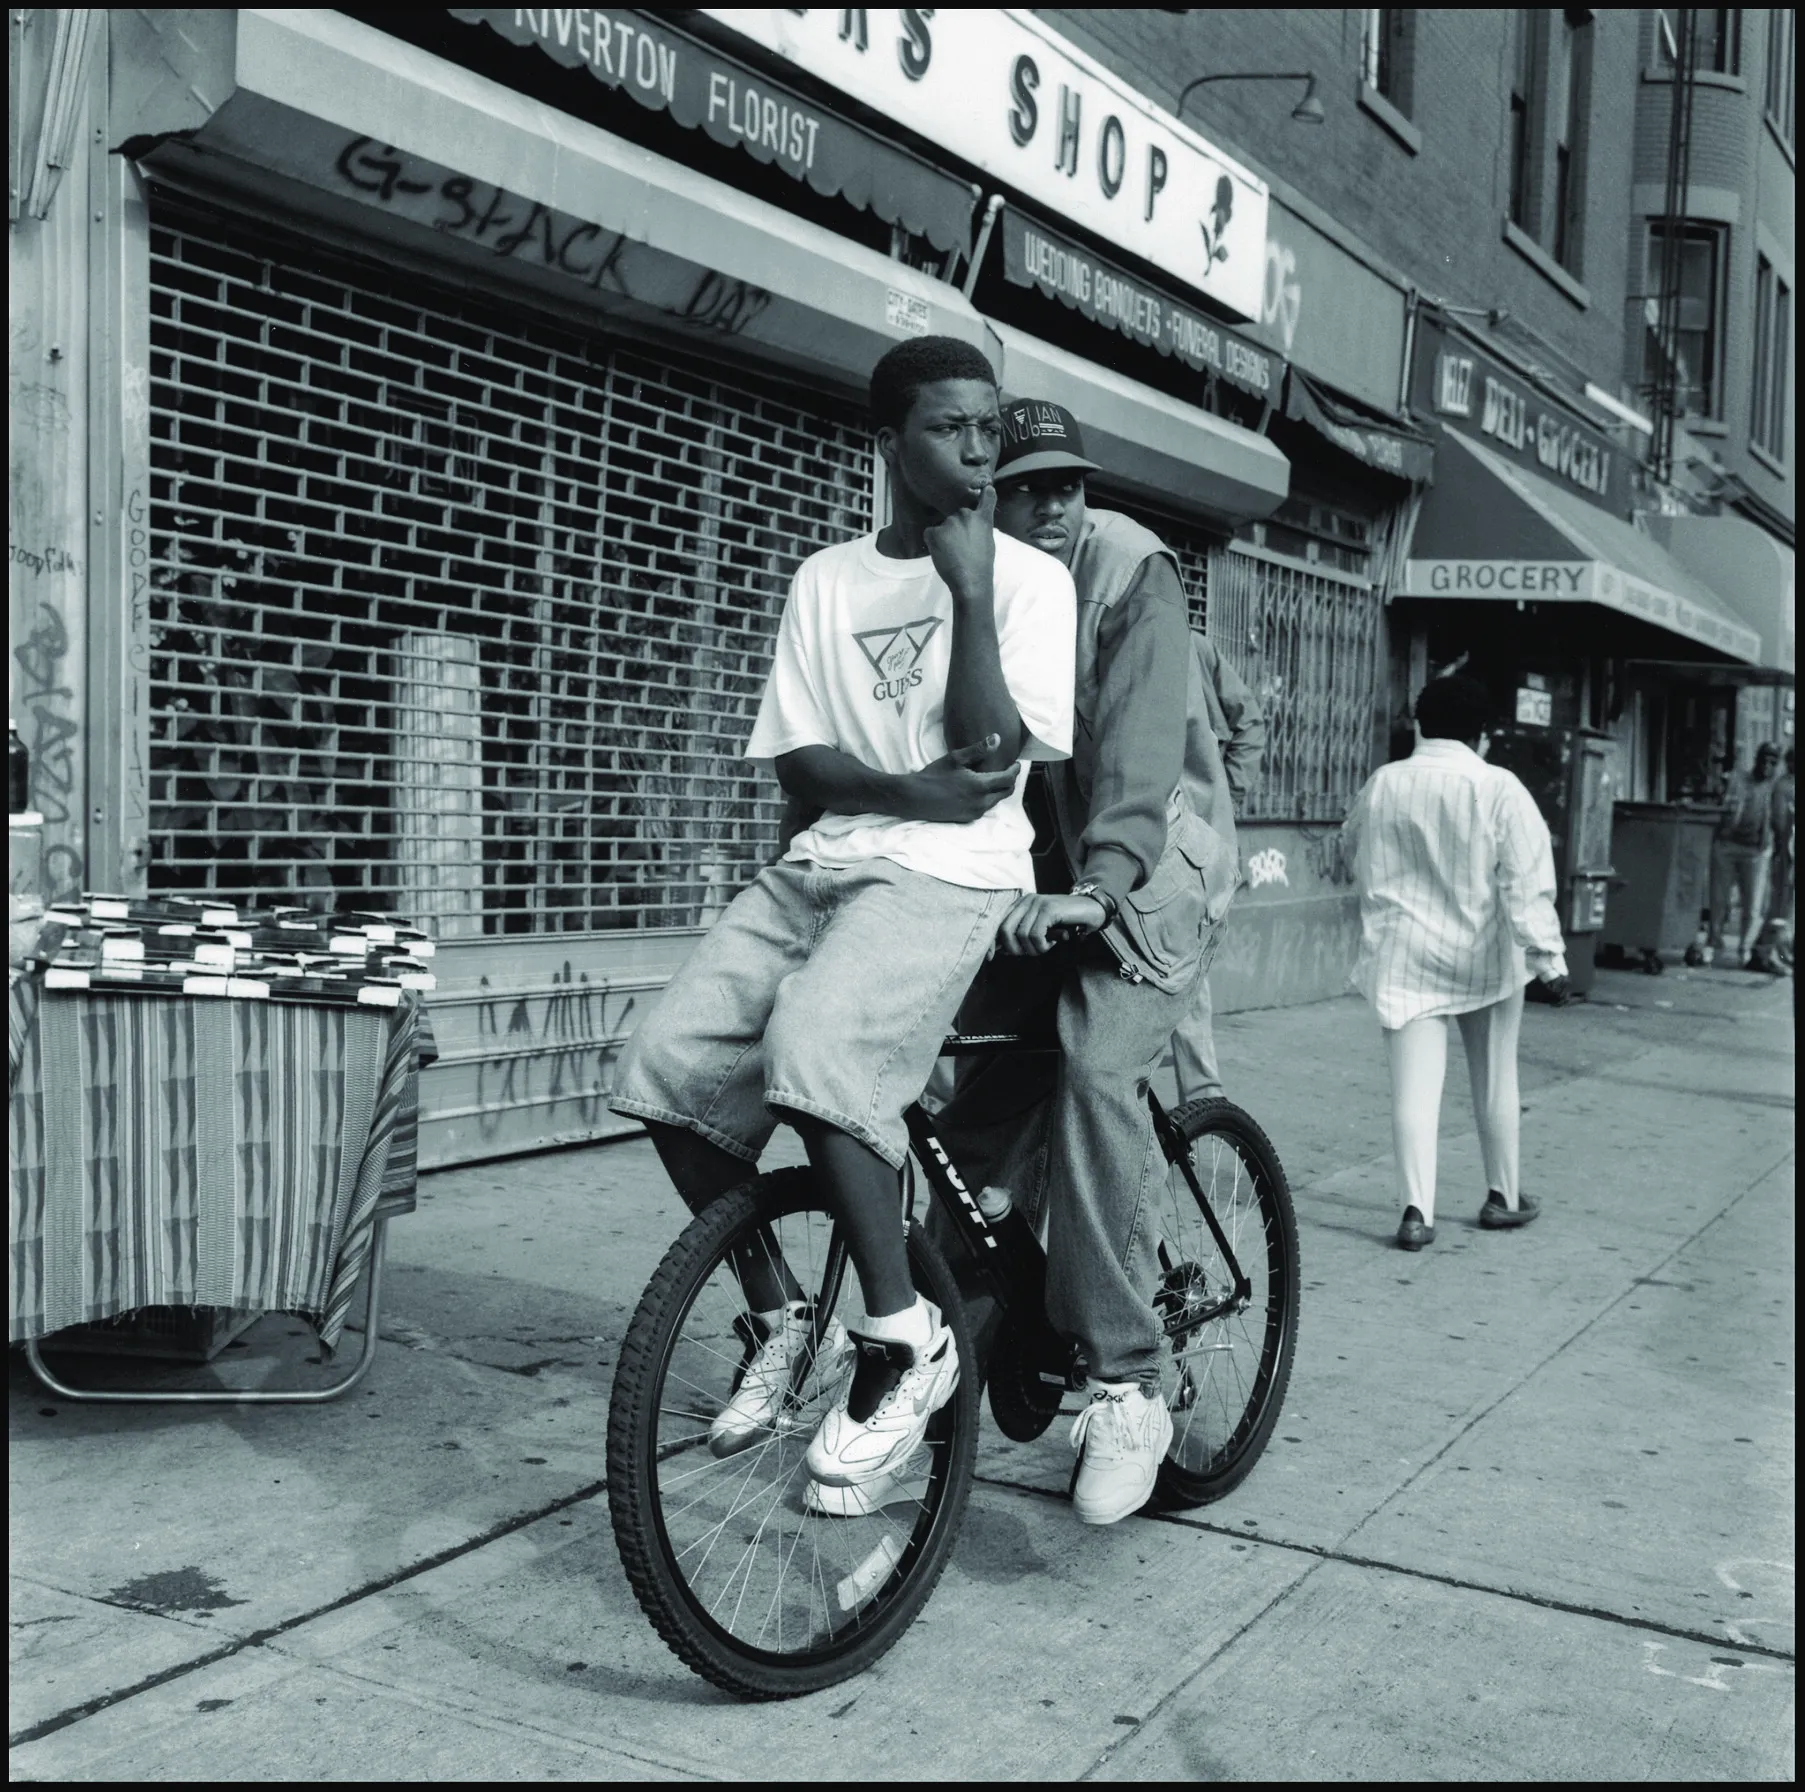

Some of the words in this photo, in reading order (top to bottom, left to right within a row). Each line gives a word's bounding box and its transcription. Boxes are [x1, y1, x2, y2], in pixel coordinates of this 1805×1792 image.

[708, 71, 820, 169] FLORIST
[1007, 54, 1168, 222] SHOP
[1024, 231, 1091, 302] WEDDING
[1094, 270, 1160, 339] BANQUETS
[1226, 339, 1270, 391] DESIGNS
[1430, 564, 1585, 593] GROCERY
